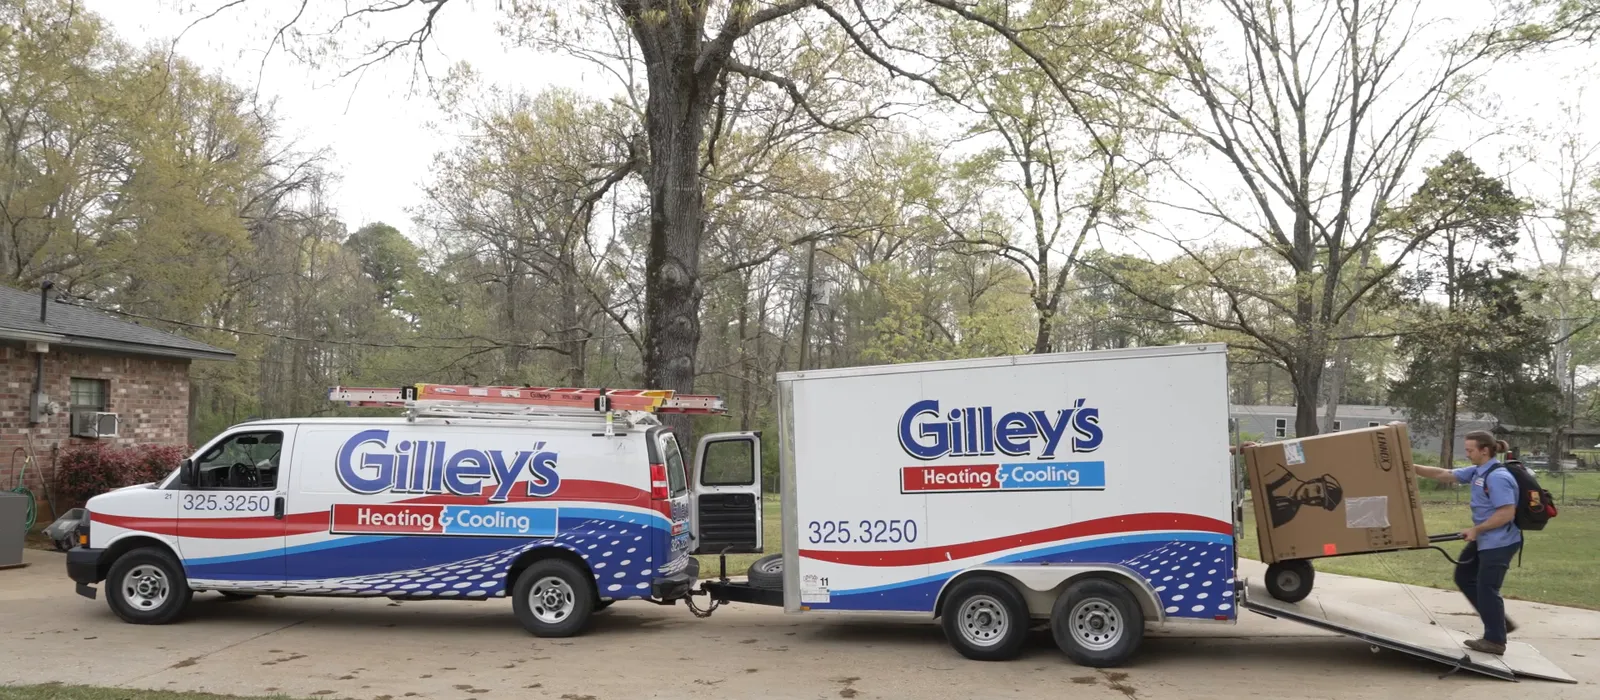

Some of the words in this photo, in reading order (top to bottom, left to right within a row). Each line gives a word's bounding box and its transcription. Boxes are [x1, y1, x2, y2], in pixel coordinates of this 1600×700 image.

[897, 398, 1104, 460] Gilley's
[335, 429, 562, 504] Gilley's
[924, 467, 991, 487] Heating
[995, 467, 1009, 484] &
[1011, 466, 1080, 485] Cooling
[183, 493, 270, 512] 325.3250
[357, 508, 434, 531] Heating
[438, 509, 454, 527] &
[457, 510, 530, 533] Cooling
[808, 519, 918, 544] 325.3250
[819, 577, 829, 586] 11
